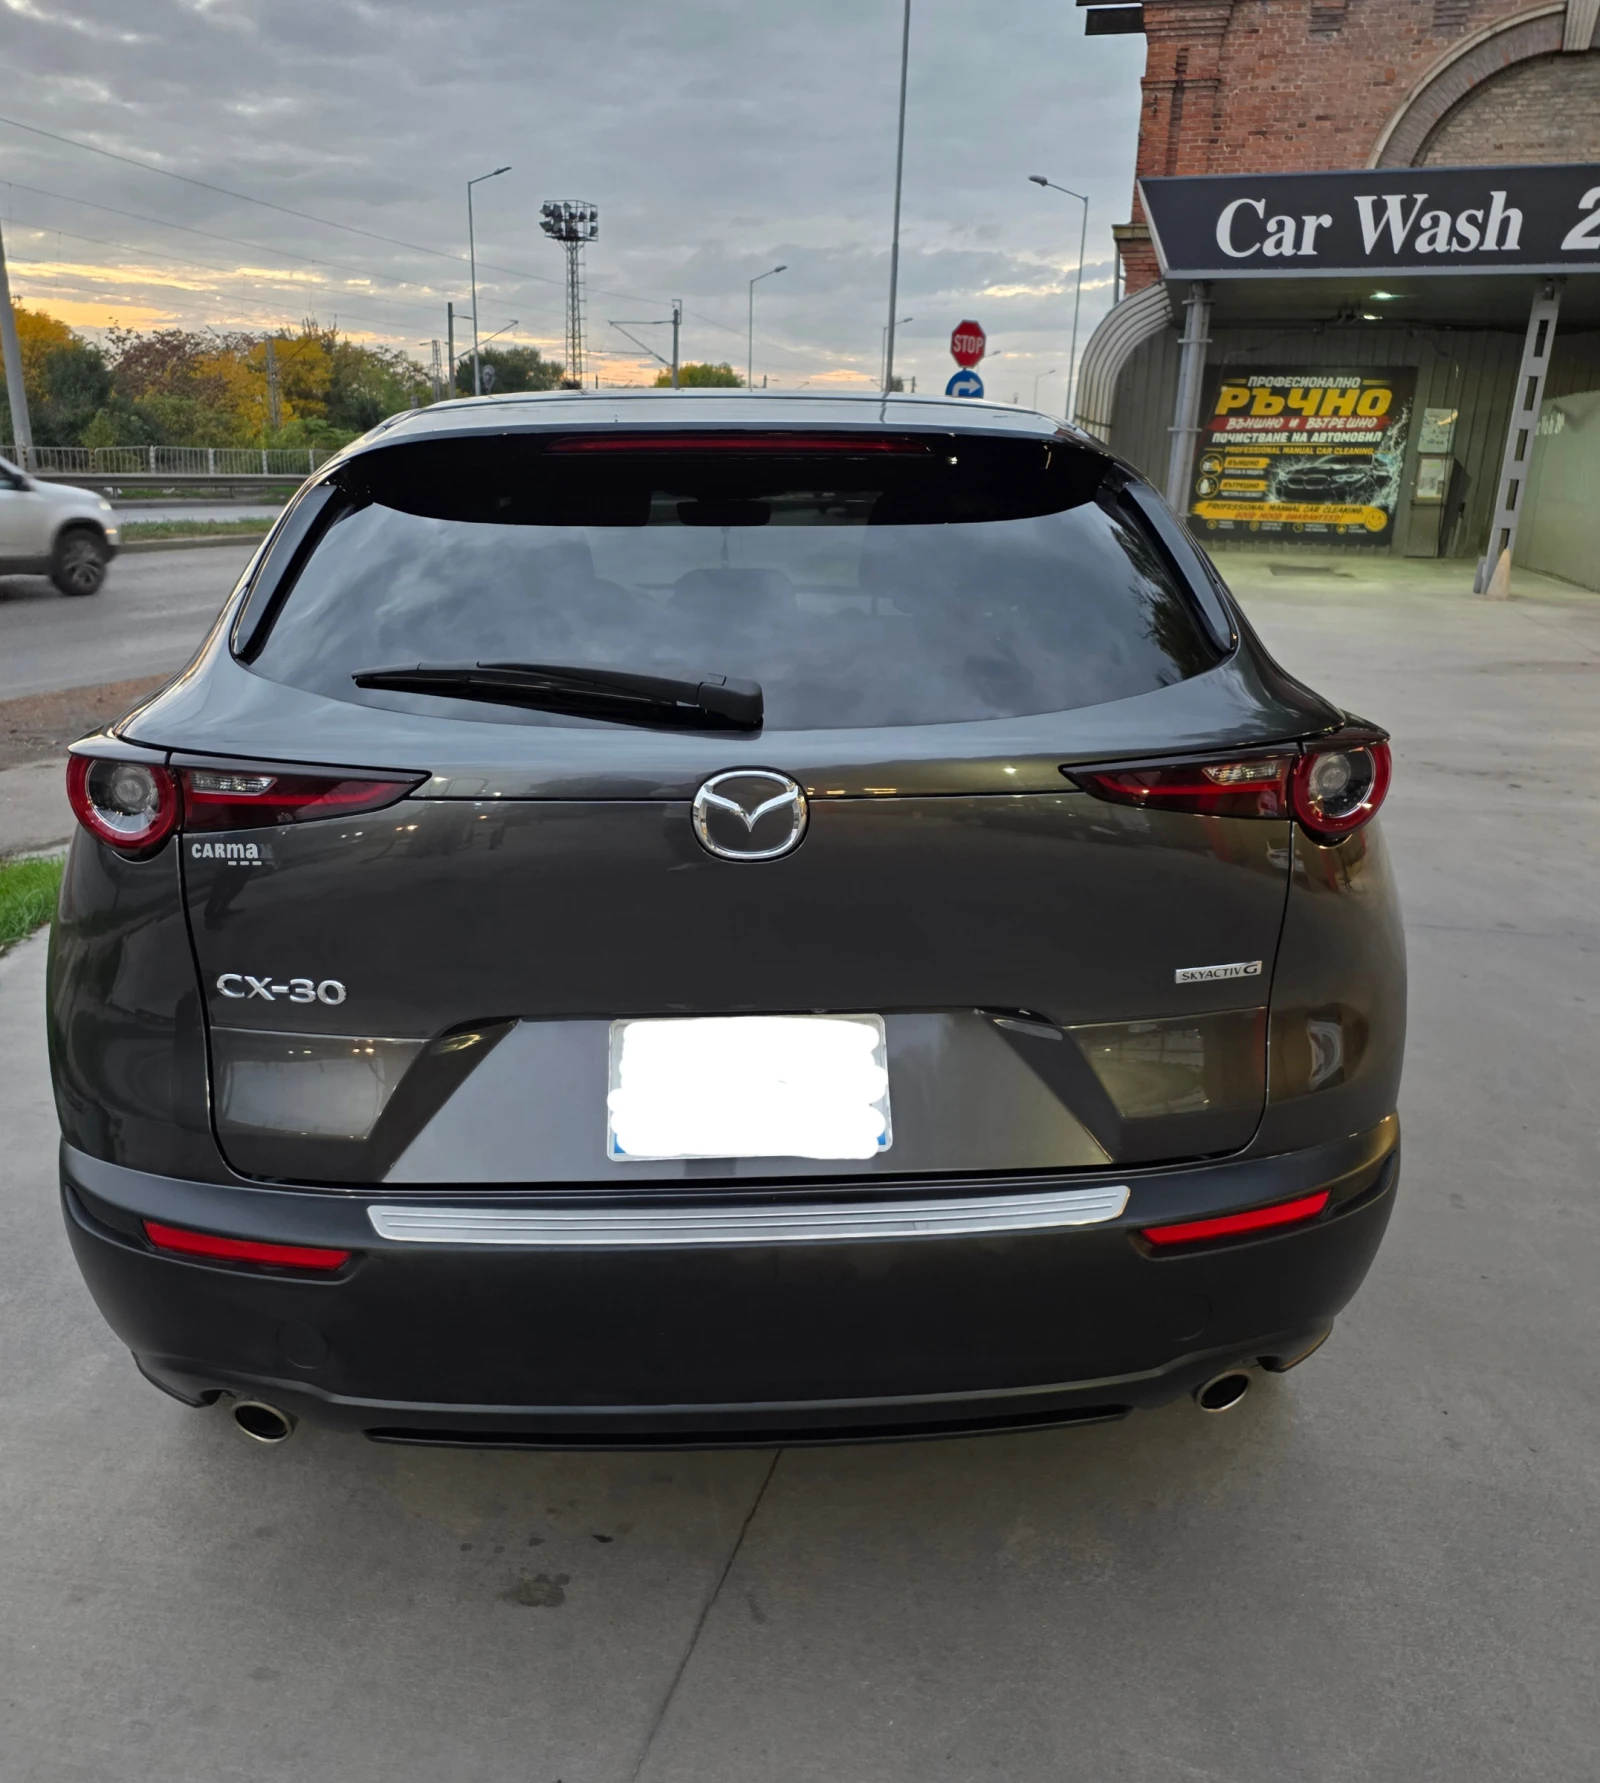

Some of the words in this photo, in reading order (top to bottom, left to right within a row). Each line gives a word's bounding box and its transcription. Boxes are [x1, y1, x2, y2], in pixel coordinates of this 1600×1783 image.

[1215, 198, 1333, 258] Car
[1353, 190, 1524, 256] Wash
[953, 335, 983, 354] STOP
[1247, 376, 1361, 388] ПРОФЕСИОНАЛНО
[1214, 387, 1393, 416] РЪЧНО
[1225, 417, 1284, 430] ВЪНШНО
[1305, 417, 1378, 429] ВЪТРЕШНО
[1212, 432, 1290, 443] ПОЧИСТВАНЕ
[1291, 432, 1308, 442] НА
[1310, 431, 1383, 442] АВТОМОБИЛ
[1224, 446, 1281, 454] PROFESSIONAL
[1334, 447, 1375, 455] CLEANING
[1206, 502, 1265, 511] PROFESSIONAL
[1268, 504, 1300, 512] MANUAL
[1303, 505, 1320, 513] CAR
[216, 973, 347, 1005] CX-30
